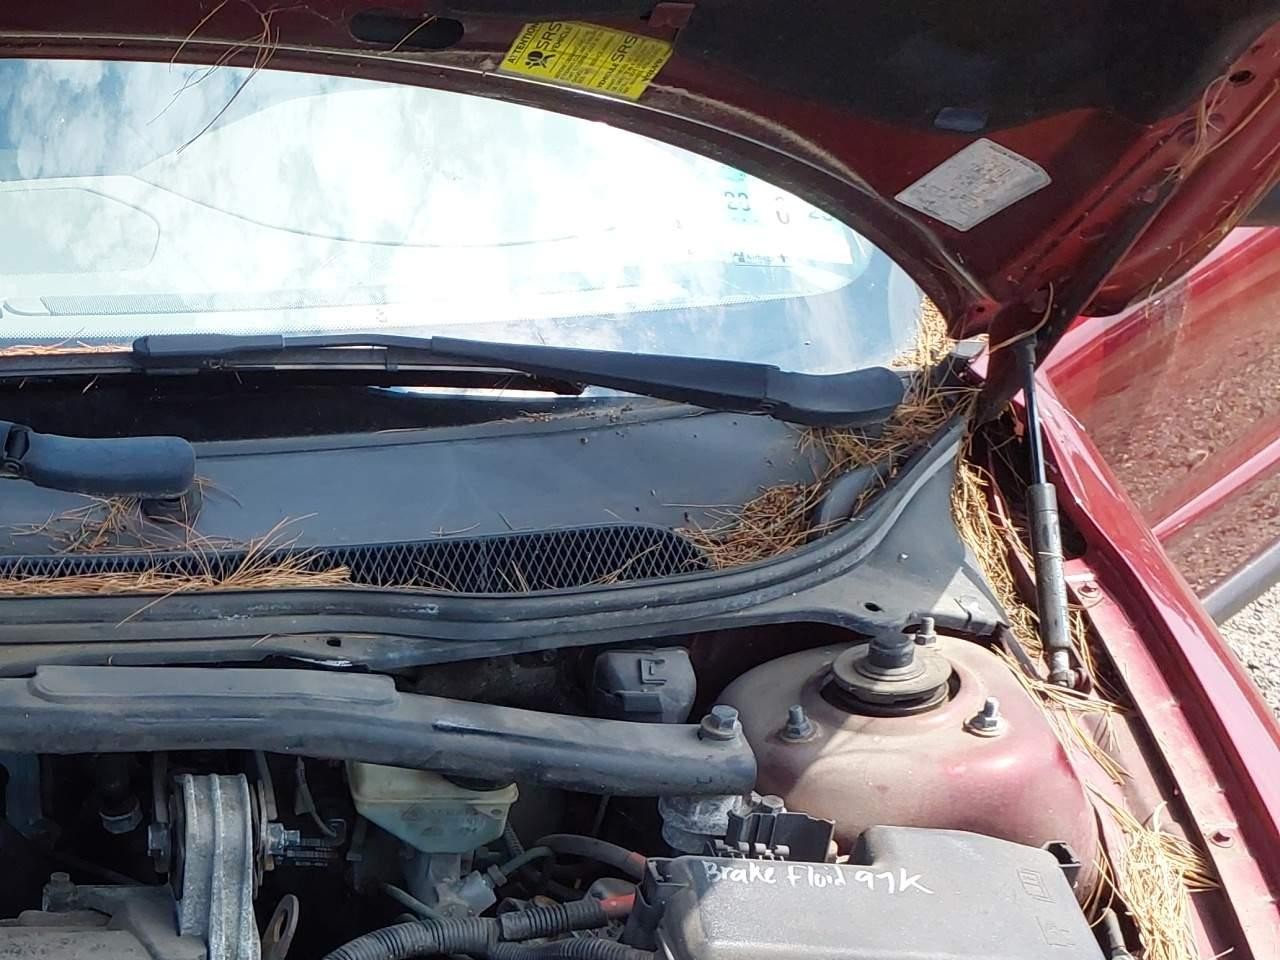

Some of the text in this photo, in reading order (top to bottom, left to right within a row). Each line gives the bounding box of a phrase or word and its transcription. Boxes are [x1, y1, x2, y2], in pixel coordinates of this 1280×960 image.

[537, 22, 562, 50] SRS
[611, 35, 638, 63] SRS
[702, 860, 777, 884] Brake
